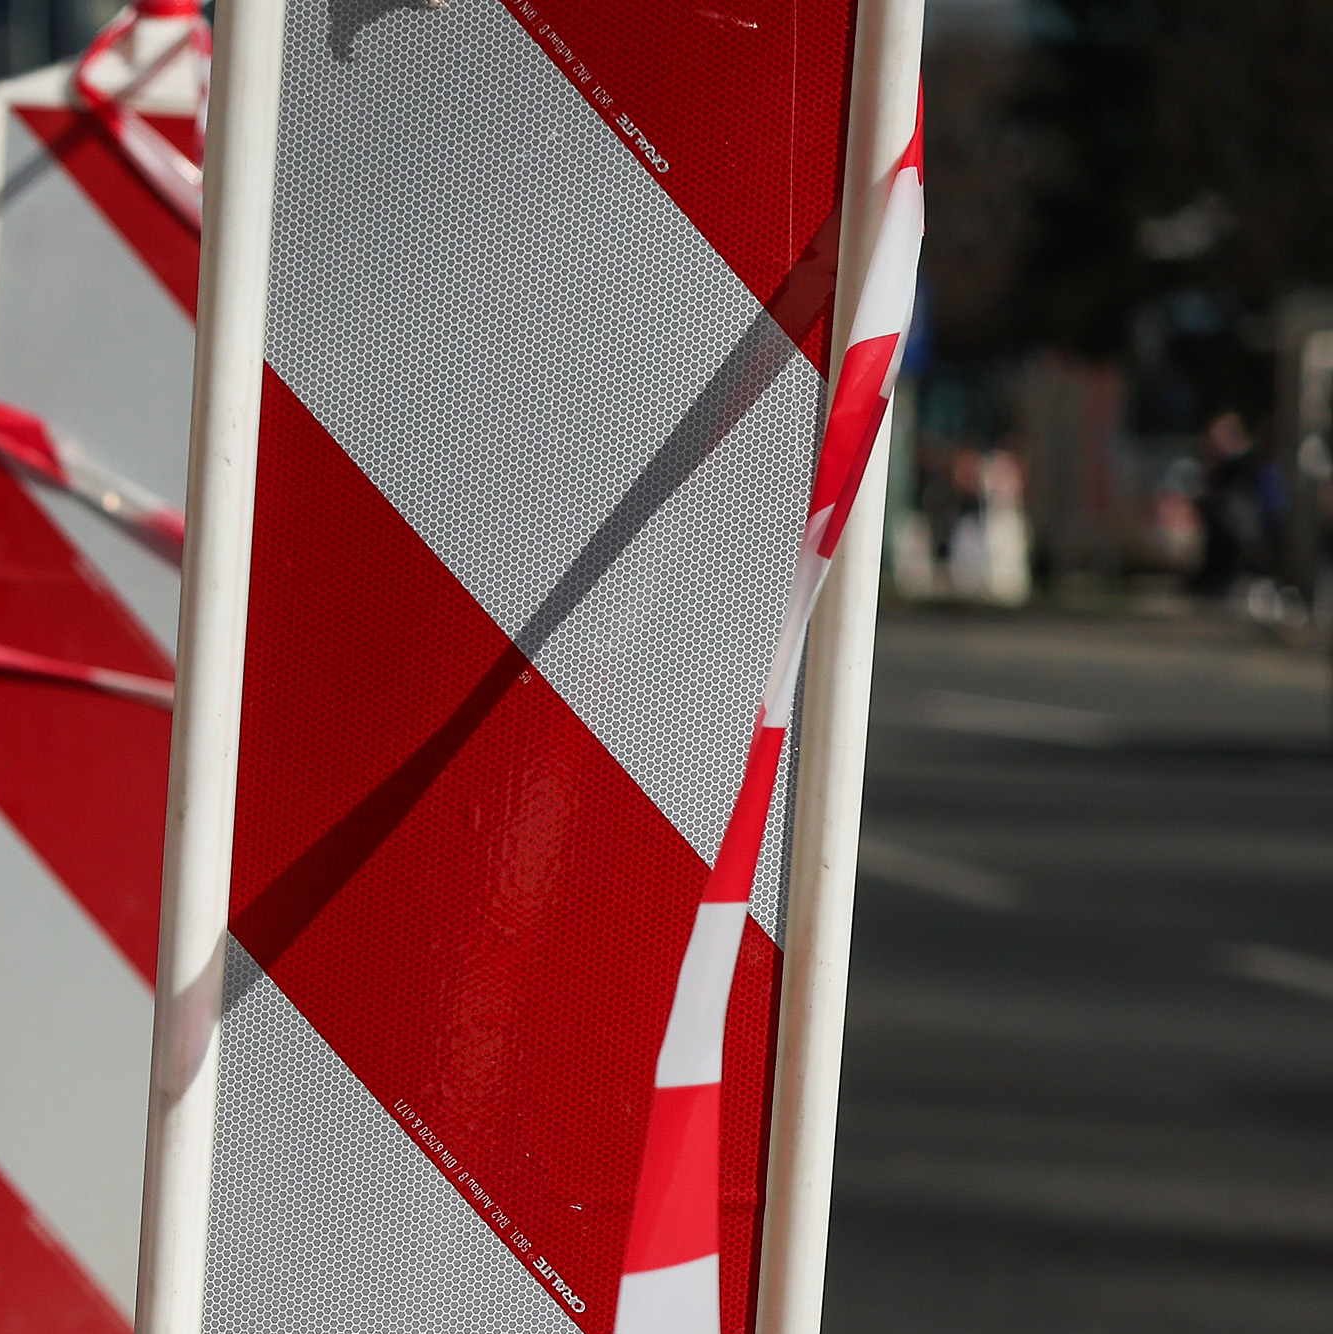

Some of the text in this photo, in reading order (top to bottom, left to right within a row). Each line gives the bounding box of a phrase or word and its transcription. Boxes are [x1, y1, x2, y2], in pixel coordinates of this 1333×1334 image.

[546, 31, 575, 63] Aufbau
[393, 1098, 416, 1121] 6171
[411, 1117, 423, 1129] &
[417, 1126, 444, 1153] 67520
[438, 1149, 458, 1169] DIN
[457, 1171, 470, 1182] B
[466, 1178, 495, 1209] Aufbau
